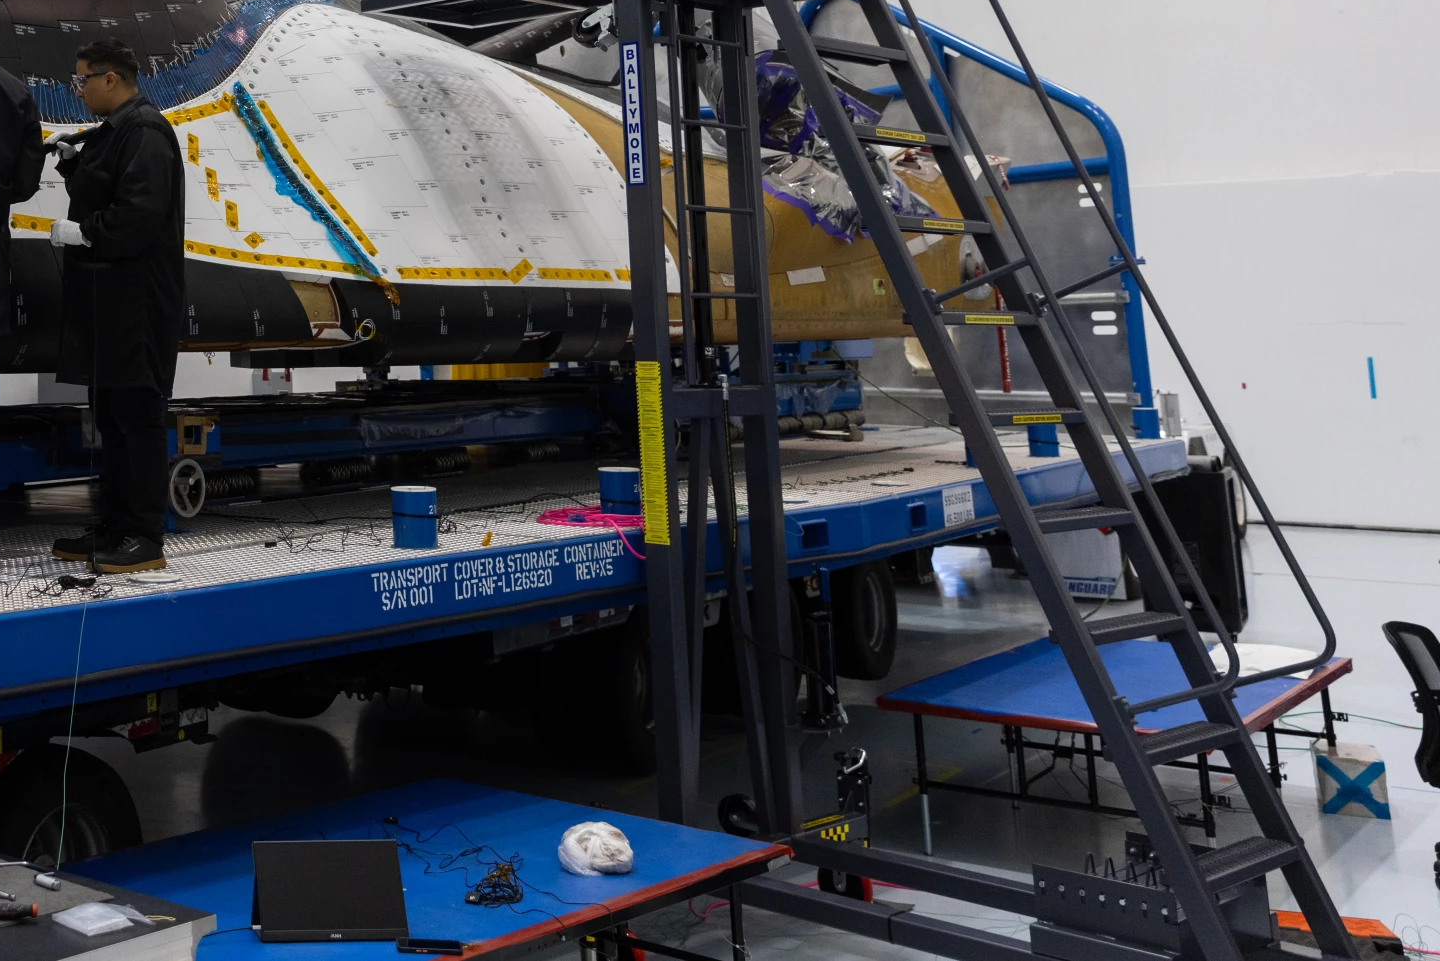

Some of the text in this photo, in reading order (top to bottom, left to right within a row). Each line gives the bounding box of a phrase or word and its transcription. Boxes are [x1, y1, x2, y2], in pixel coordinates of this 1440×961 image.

[626, 49, 641, 179] BALLYMORE
[371, 539, 624, 592] TRANSPORT COVER & STORAGE CONTAINER
[575, 558, 614, 581] REV:X5
[381, 585, 434, 612] S/N 001
[1067, 581, 1117, 595] NGUARD
